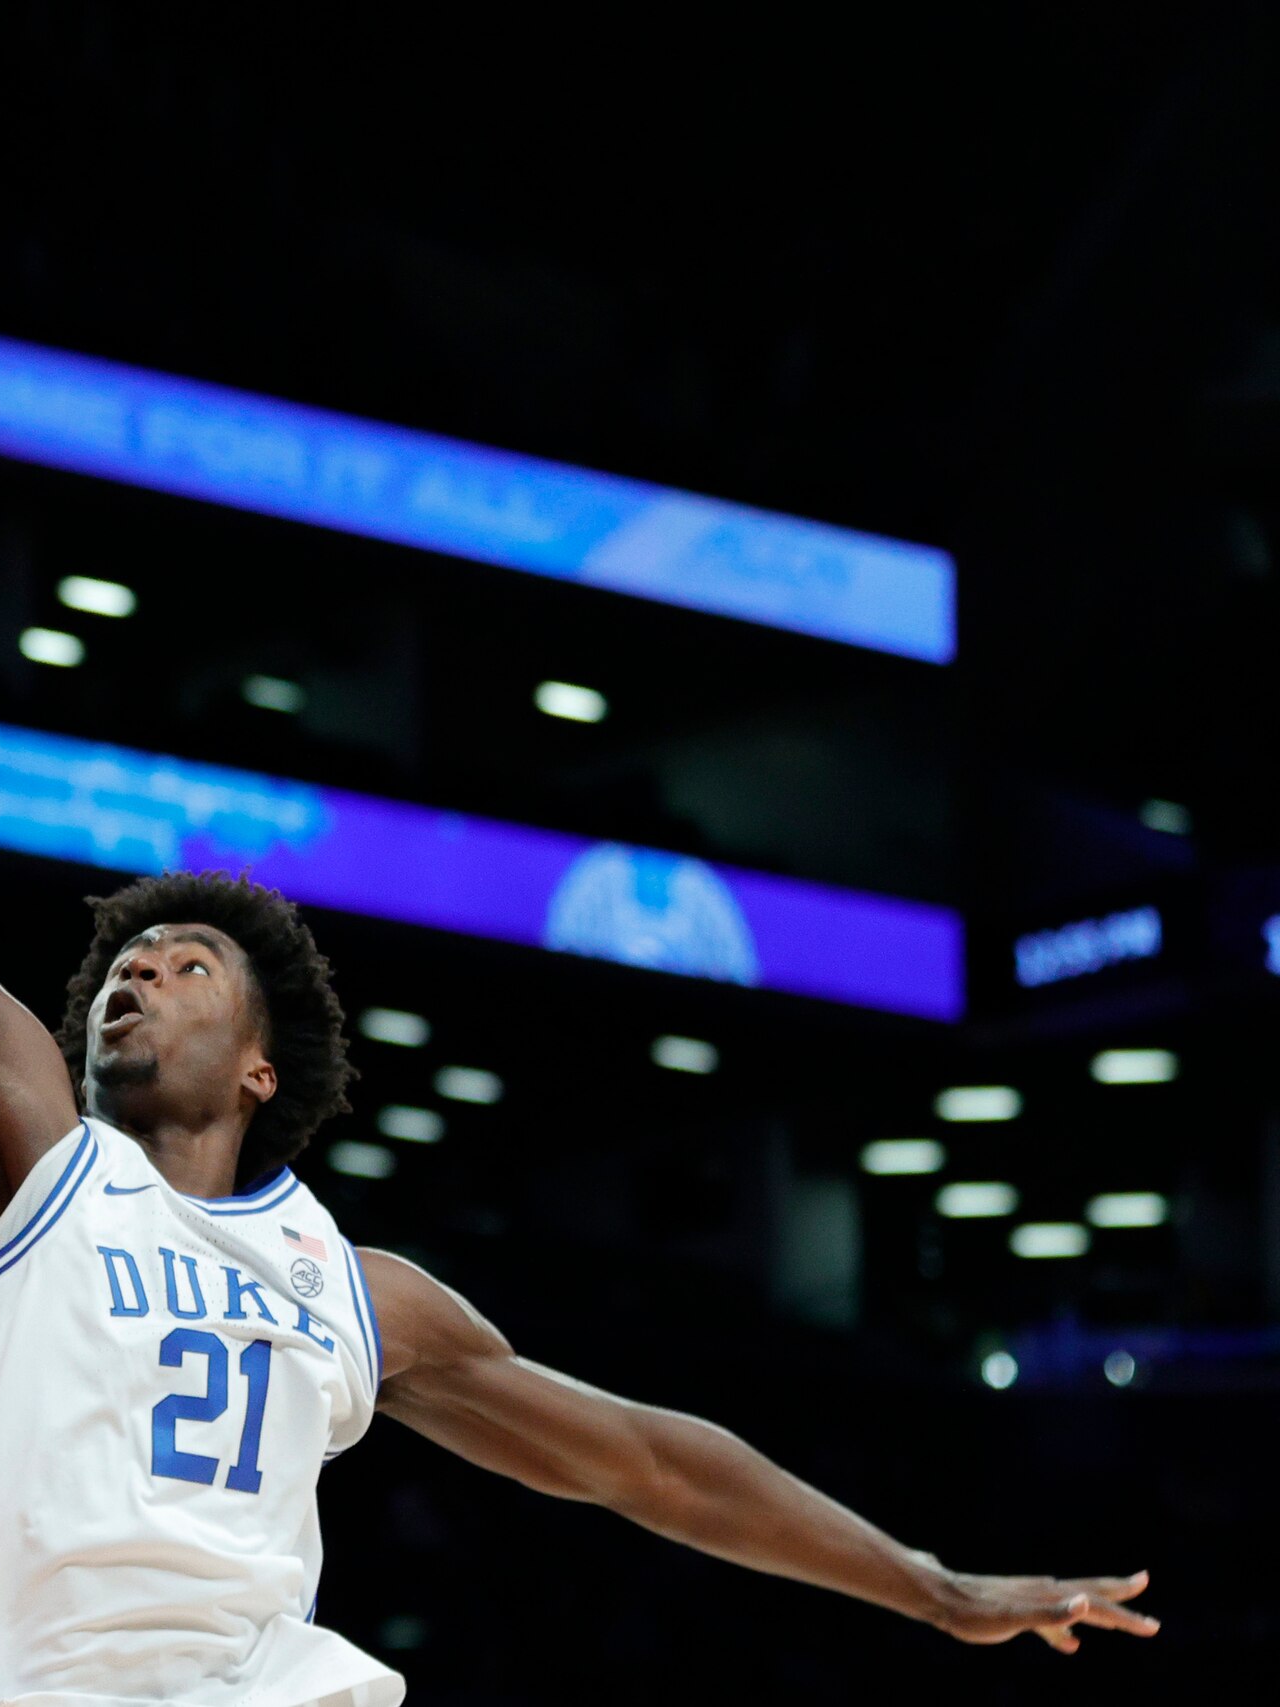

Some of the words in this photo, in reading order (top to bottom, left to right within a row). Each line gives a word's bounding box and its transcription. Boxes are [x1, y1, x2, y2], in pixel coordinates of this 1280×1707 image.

[97, 1245, 335, 1354] DUKE
[295, 1269, 323, 1286] ACC
[151, 1327, 273, 1495] 21
